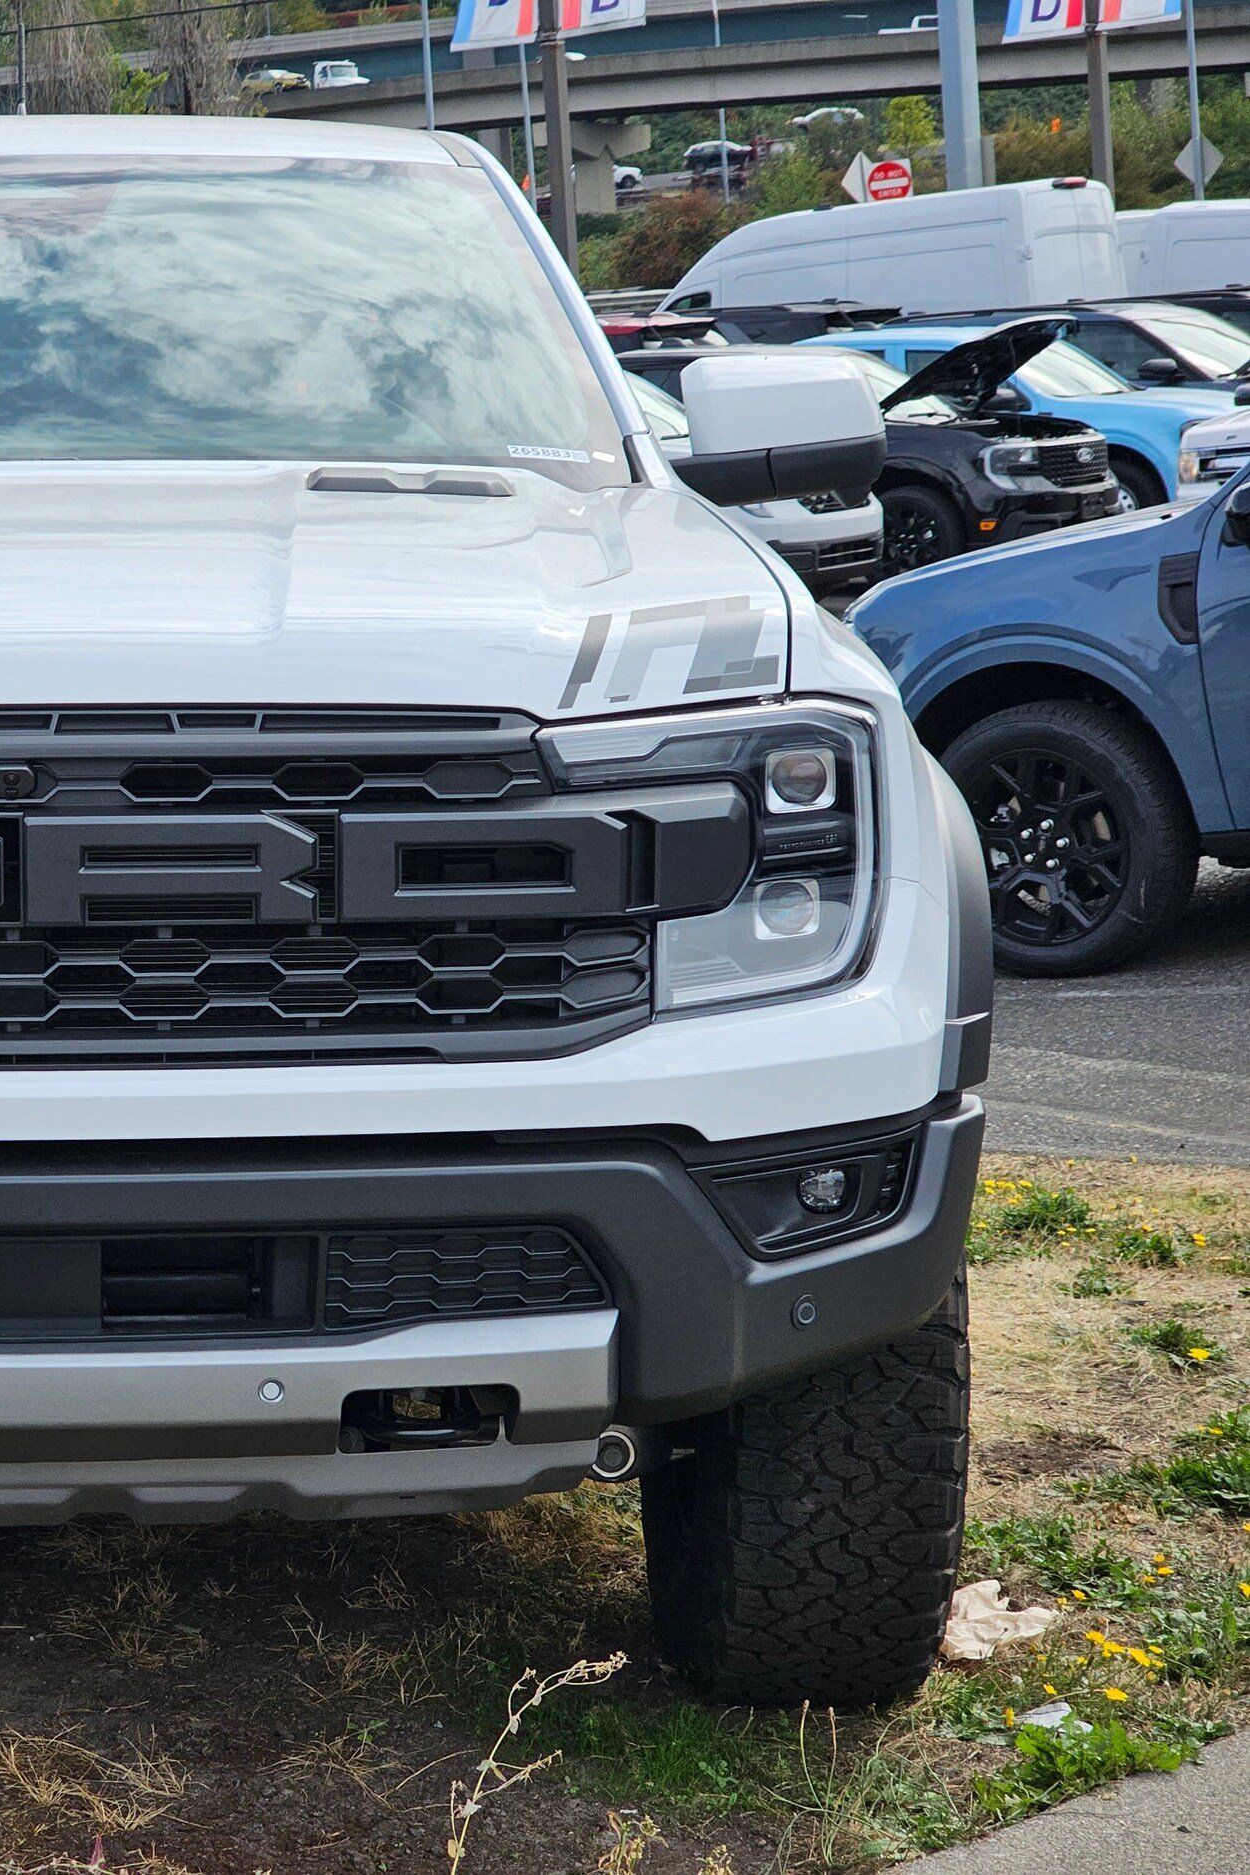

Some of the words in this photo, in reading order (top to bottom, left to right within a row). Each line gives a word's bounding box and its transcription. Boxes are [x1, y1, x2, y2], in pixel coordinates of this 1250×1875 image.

[873, 171, 885, 180] DO
[888, 169, 903, 178] NOT
[877, 188, 903, 198] ENTER
[510, 446, 572, 459] 265883
